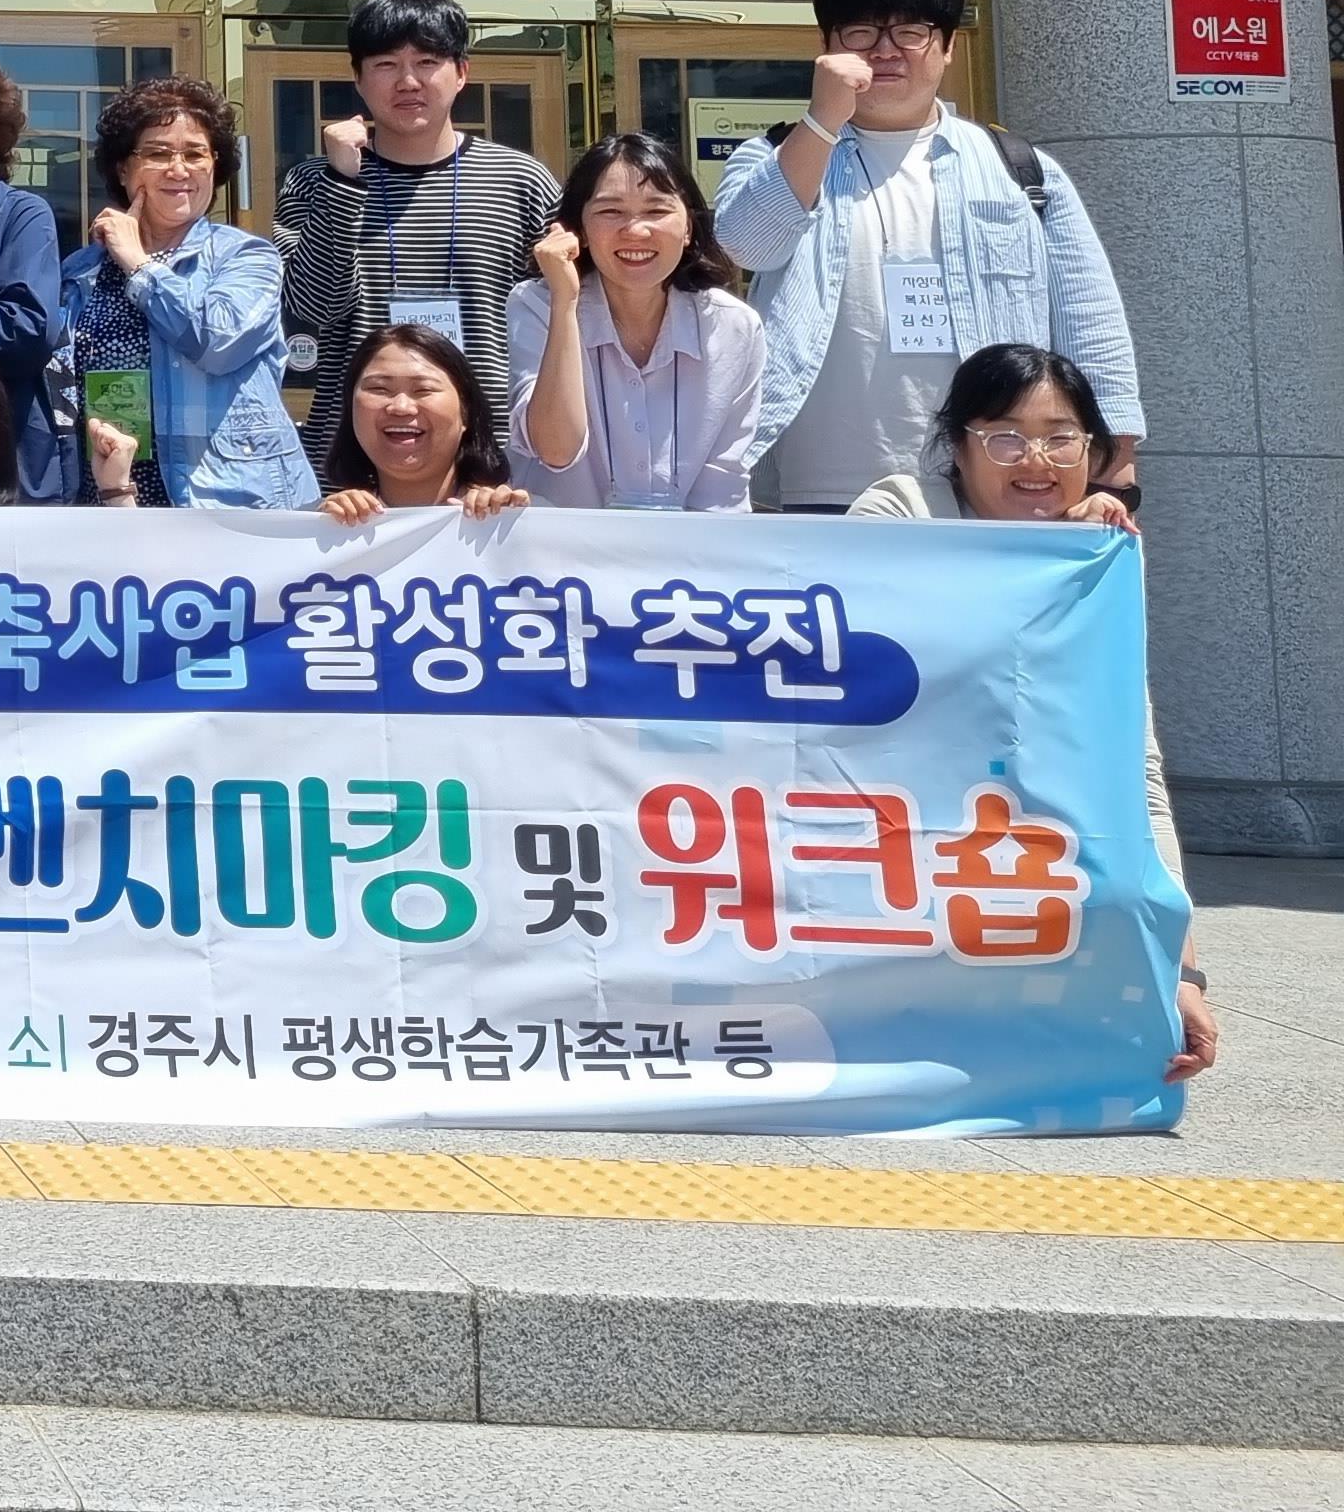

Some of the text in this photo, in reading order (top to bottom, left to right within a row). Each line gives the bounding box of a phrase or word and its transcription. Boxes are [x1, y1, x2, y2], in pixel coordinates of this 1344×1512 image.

[1192, 16, 1268, 45] 에스원
[1206, 51, 1233, 61] CCTV
[1176, 80, 1244, 96] SECOM
[284, 583, 600, 696] 활성화
[631, 590, 848, 702] 추진
[513, 821, 605, 938] 및
[637, 782, 1081, 958] 워크숍
[87, 1011, 257, 1080] 경주시
[280, 1014, 691, 1082] 평생학습가족관
[712, 1018, 775, 1080] 등
